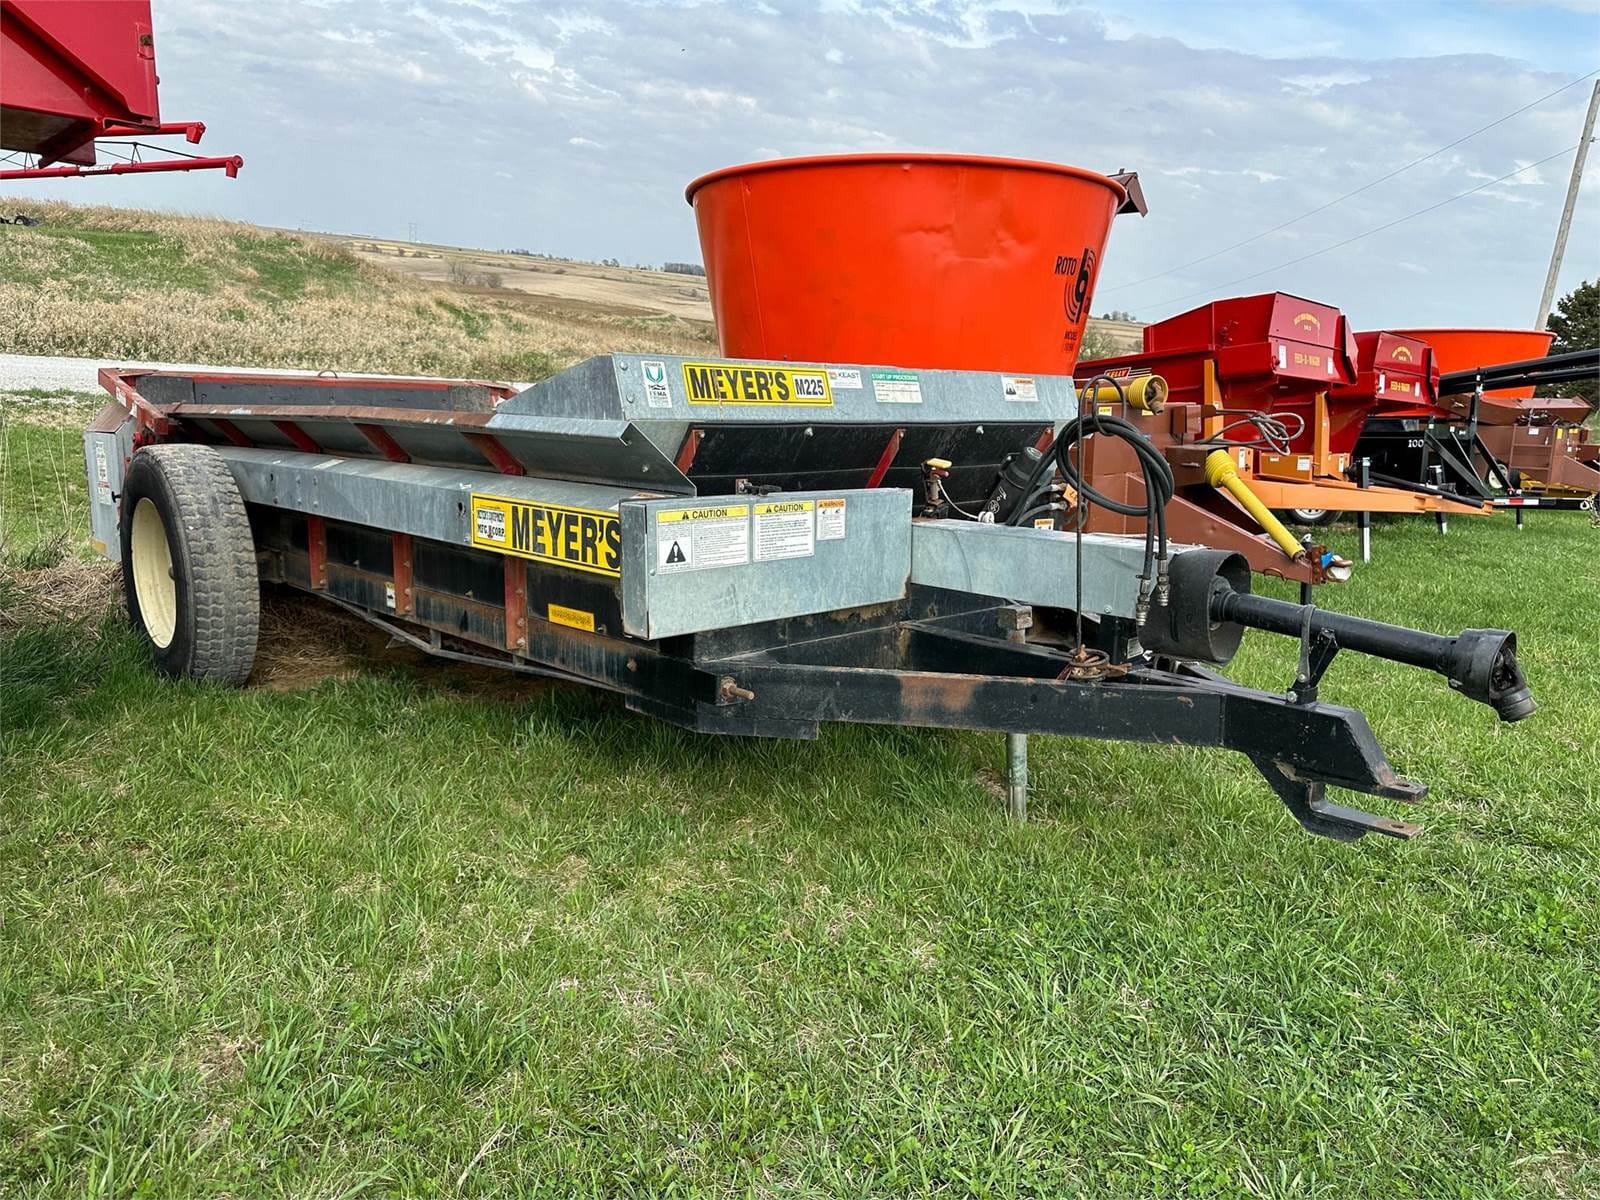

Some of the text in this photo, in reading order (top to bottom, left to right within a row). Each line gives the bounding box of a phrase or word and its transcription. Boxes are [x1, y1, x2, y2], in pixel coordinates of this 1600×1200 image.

[1055, 255, 1078, 275] ROTO
[689, 368, 824, 401] MEYER'S M225
[1408, 439, 1424, 448] 100
[692, 509, 728, 519] CAUTION
[773, 503, 804, 513] CAUTION
[512, 505, 622, 569] MEYER'S
